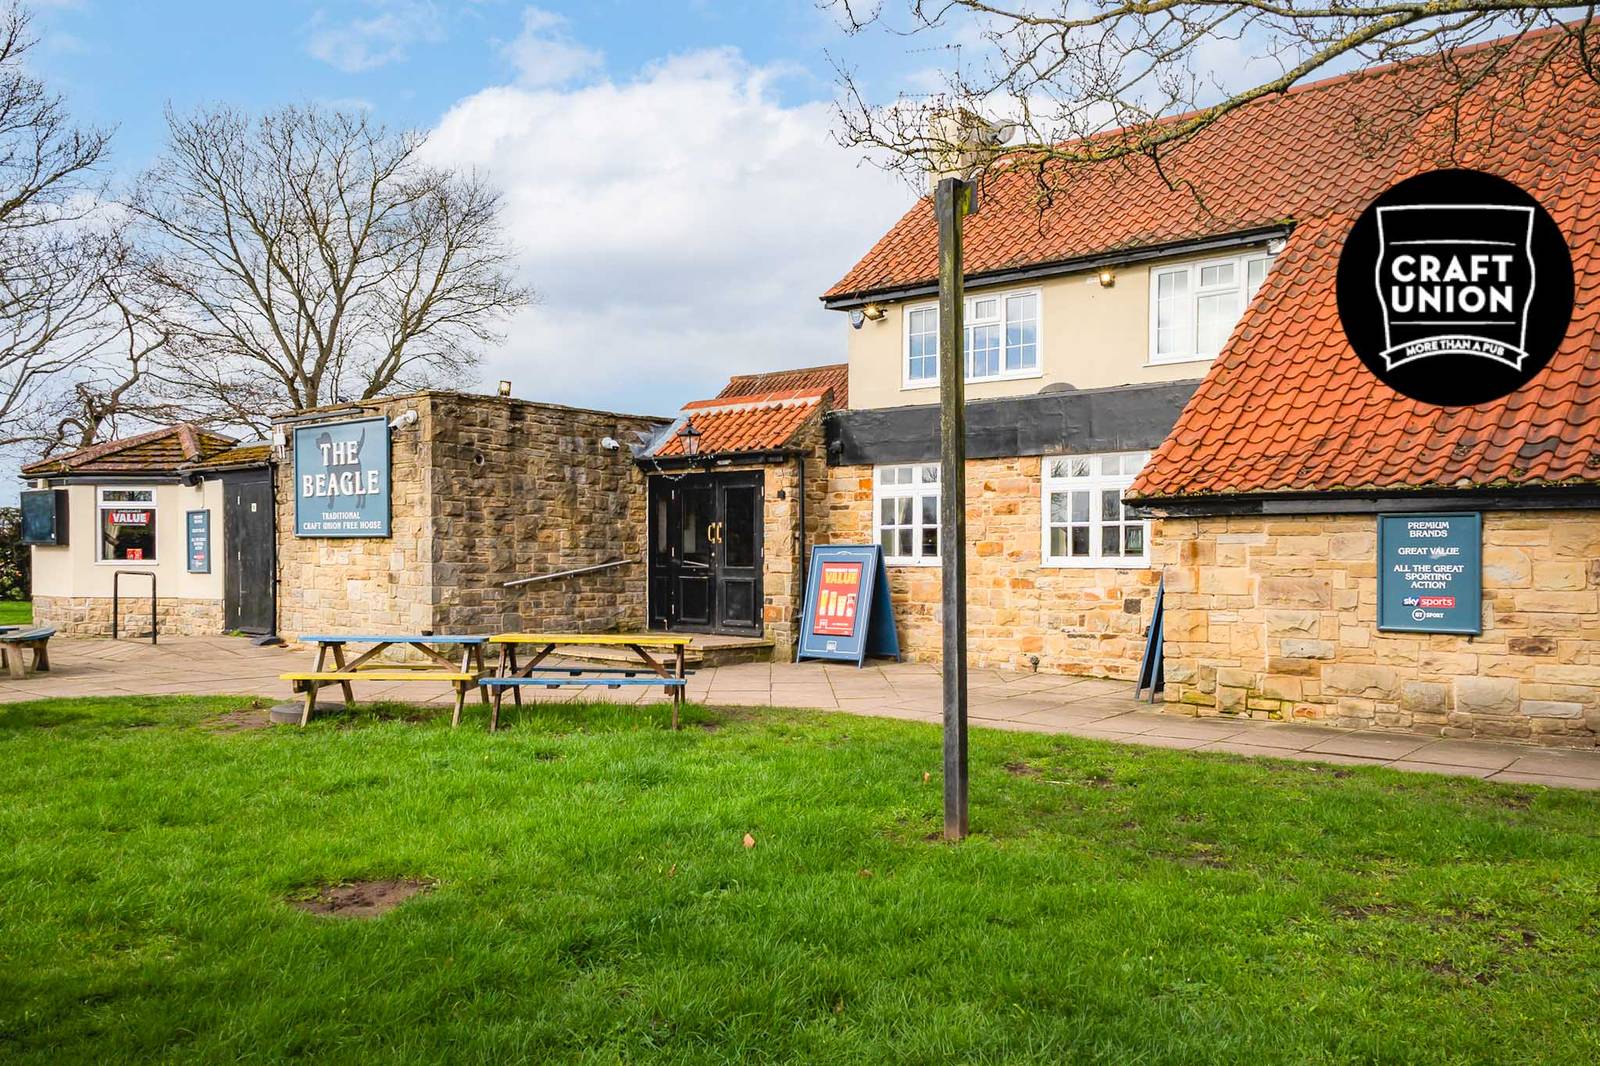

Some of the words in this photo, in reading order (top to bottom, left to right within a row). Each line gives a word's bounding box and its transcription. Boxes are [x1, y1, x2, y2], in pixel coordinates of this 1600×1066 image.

[320, 440, 359, 466] THE
[302, 469, 380, 497] BEAGLE
[112, 512, 147, 523] VALUE
[321, 511, 360, 520] TRADITIONAL
[303, 521, 321, 530] CRAFT
[322, 521, 341, 530] UNION
[342, 520, 358, 529] FREE
[359, 520, 382, 529] HOUSE
[1407, 521, 1449, 530] PREMIUM
[1409, 529, 1448, 538] BRANDS
[1398, 547, 1428, 555] GREAT
[1429, 547, 1460, 556] VALUE
[1393, 564, 1411, 573] ALL
[1412, 564, 1432, 573] THE
[1433, 564, 1464, 573] GREAT
[825, 572, 857, 584] VALUE
[1405, 573, 1452, 581] SPORTING
[1410, 581, 1446, 589] ACTION
[1403, 597, 1419, 606] sky
[1421, 599, 1453, 607] sports
